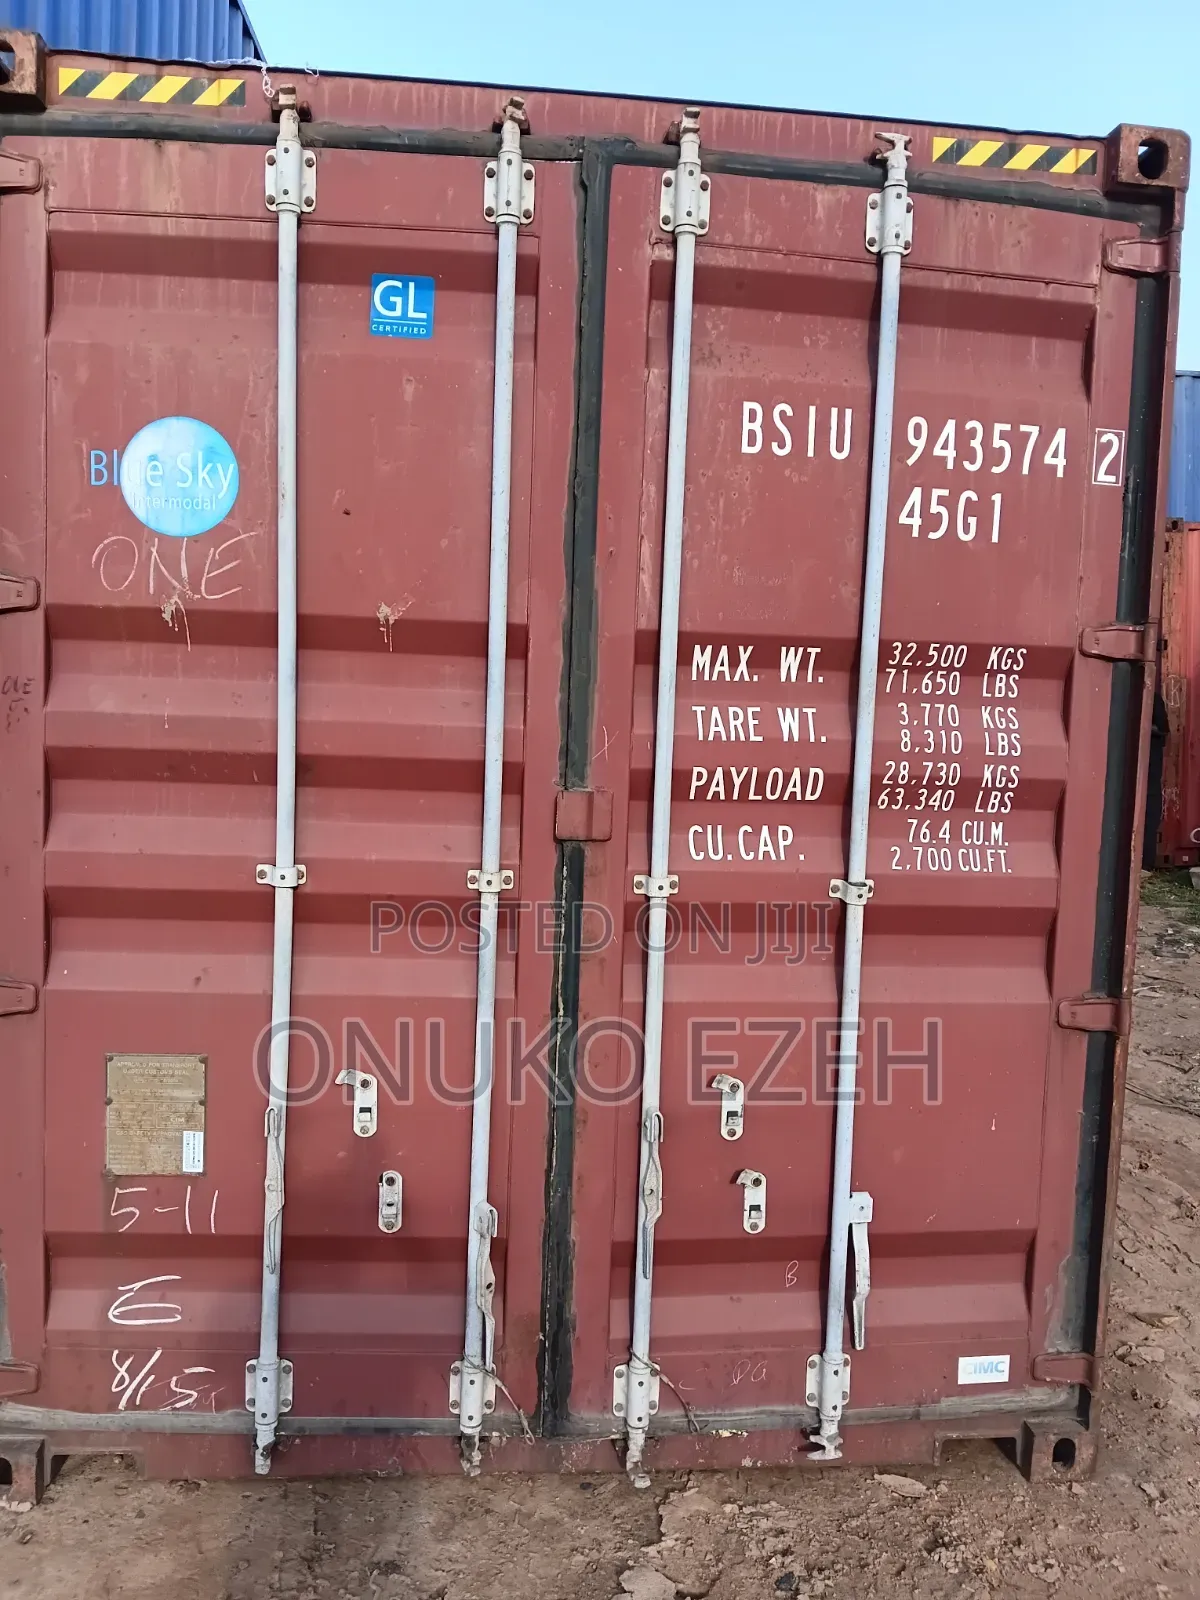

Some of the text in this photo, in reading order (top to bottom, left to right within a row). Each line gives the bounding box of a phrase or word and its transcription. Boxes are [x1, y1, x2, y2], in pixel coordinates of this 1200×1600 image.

[373, 279, 428, 319] GL
[372, 324, 427, 335] CERTIFIED
[741, 401, 1120, 482] BSIU 943574 2
[90, 449, 235, 499] Blue Sky
[899, 486, 1002, 543] 45G1
[92, 535, 258, 600] ONE
[691, 645, 824, 683] MAX. WT.
[888, 642, 1027, 671] 32,500 KGS
[885, 668, 1020, 698] 71,650 LBS
[691, 705, 827, 743] TARE WT.
[897, 702, 1019, 729] 3,770 KGS
[900, 728, 1022, 757] 8,310 LBS
[689, 766, 825, 801] PAYLOAD
[882, 761, 1021, 788] 28,730 KGS
[877, 787, 1014, 814] 63,340 LBS
[907, 818, 1009, 847] 76.4 CU.M.
[890, 846, 1012, 873] 2,700 CU.FT.
[962, 1360, 1006, 1376] CIMC
